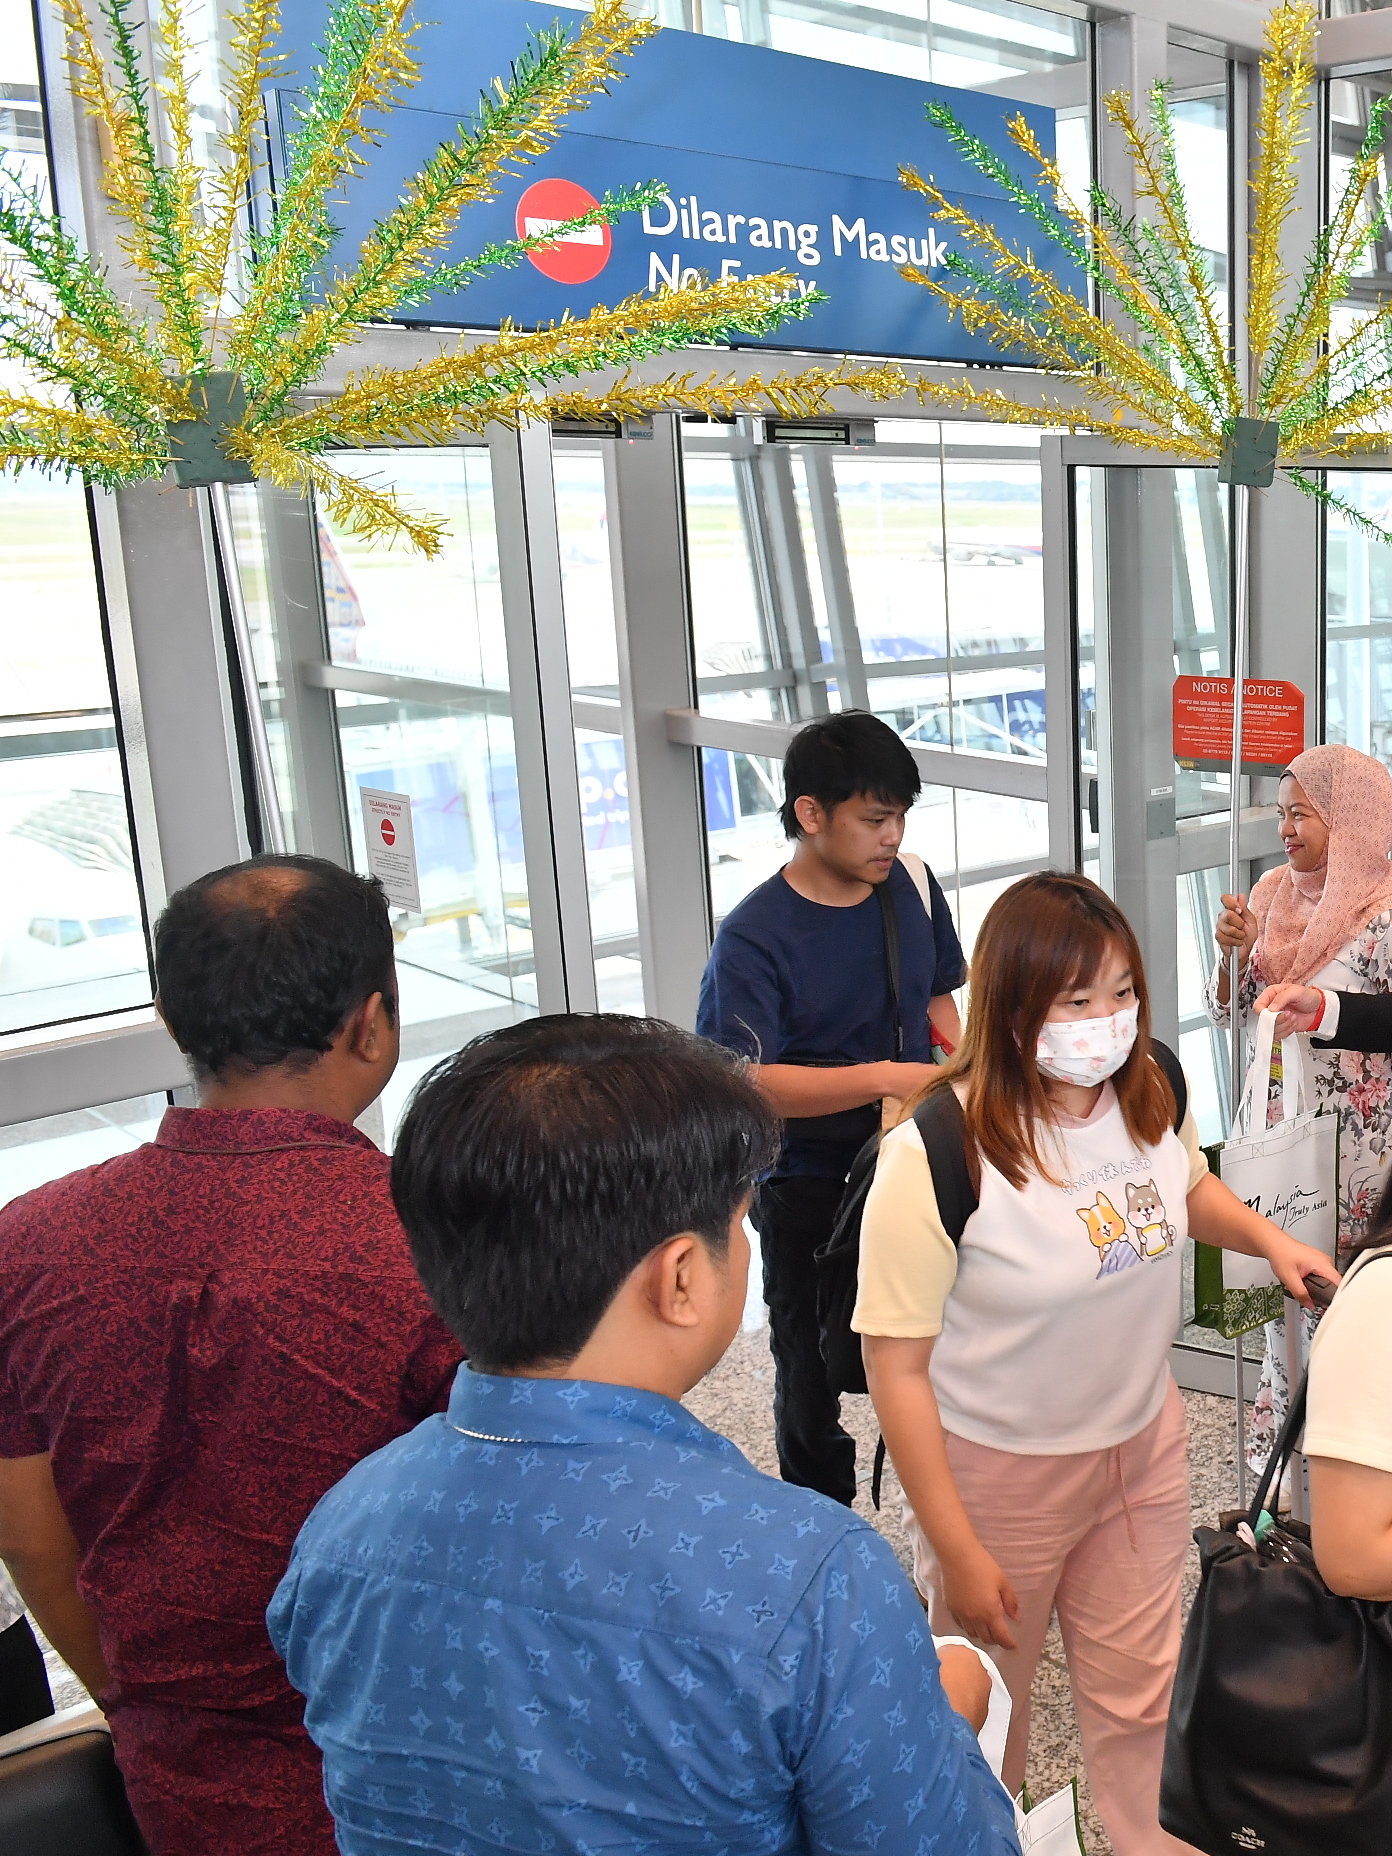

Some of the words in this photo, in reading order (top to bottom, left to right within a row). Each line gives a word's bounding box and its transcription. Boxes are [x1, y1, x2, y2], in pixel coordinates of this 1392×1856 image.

[642, 195, 821, 266] Dilarang
[831, 214, 948, 267] Masuk
[1192, 681, 1228, 694] NOTIS
[1312, 1200, 1328, 1211] Asia
